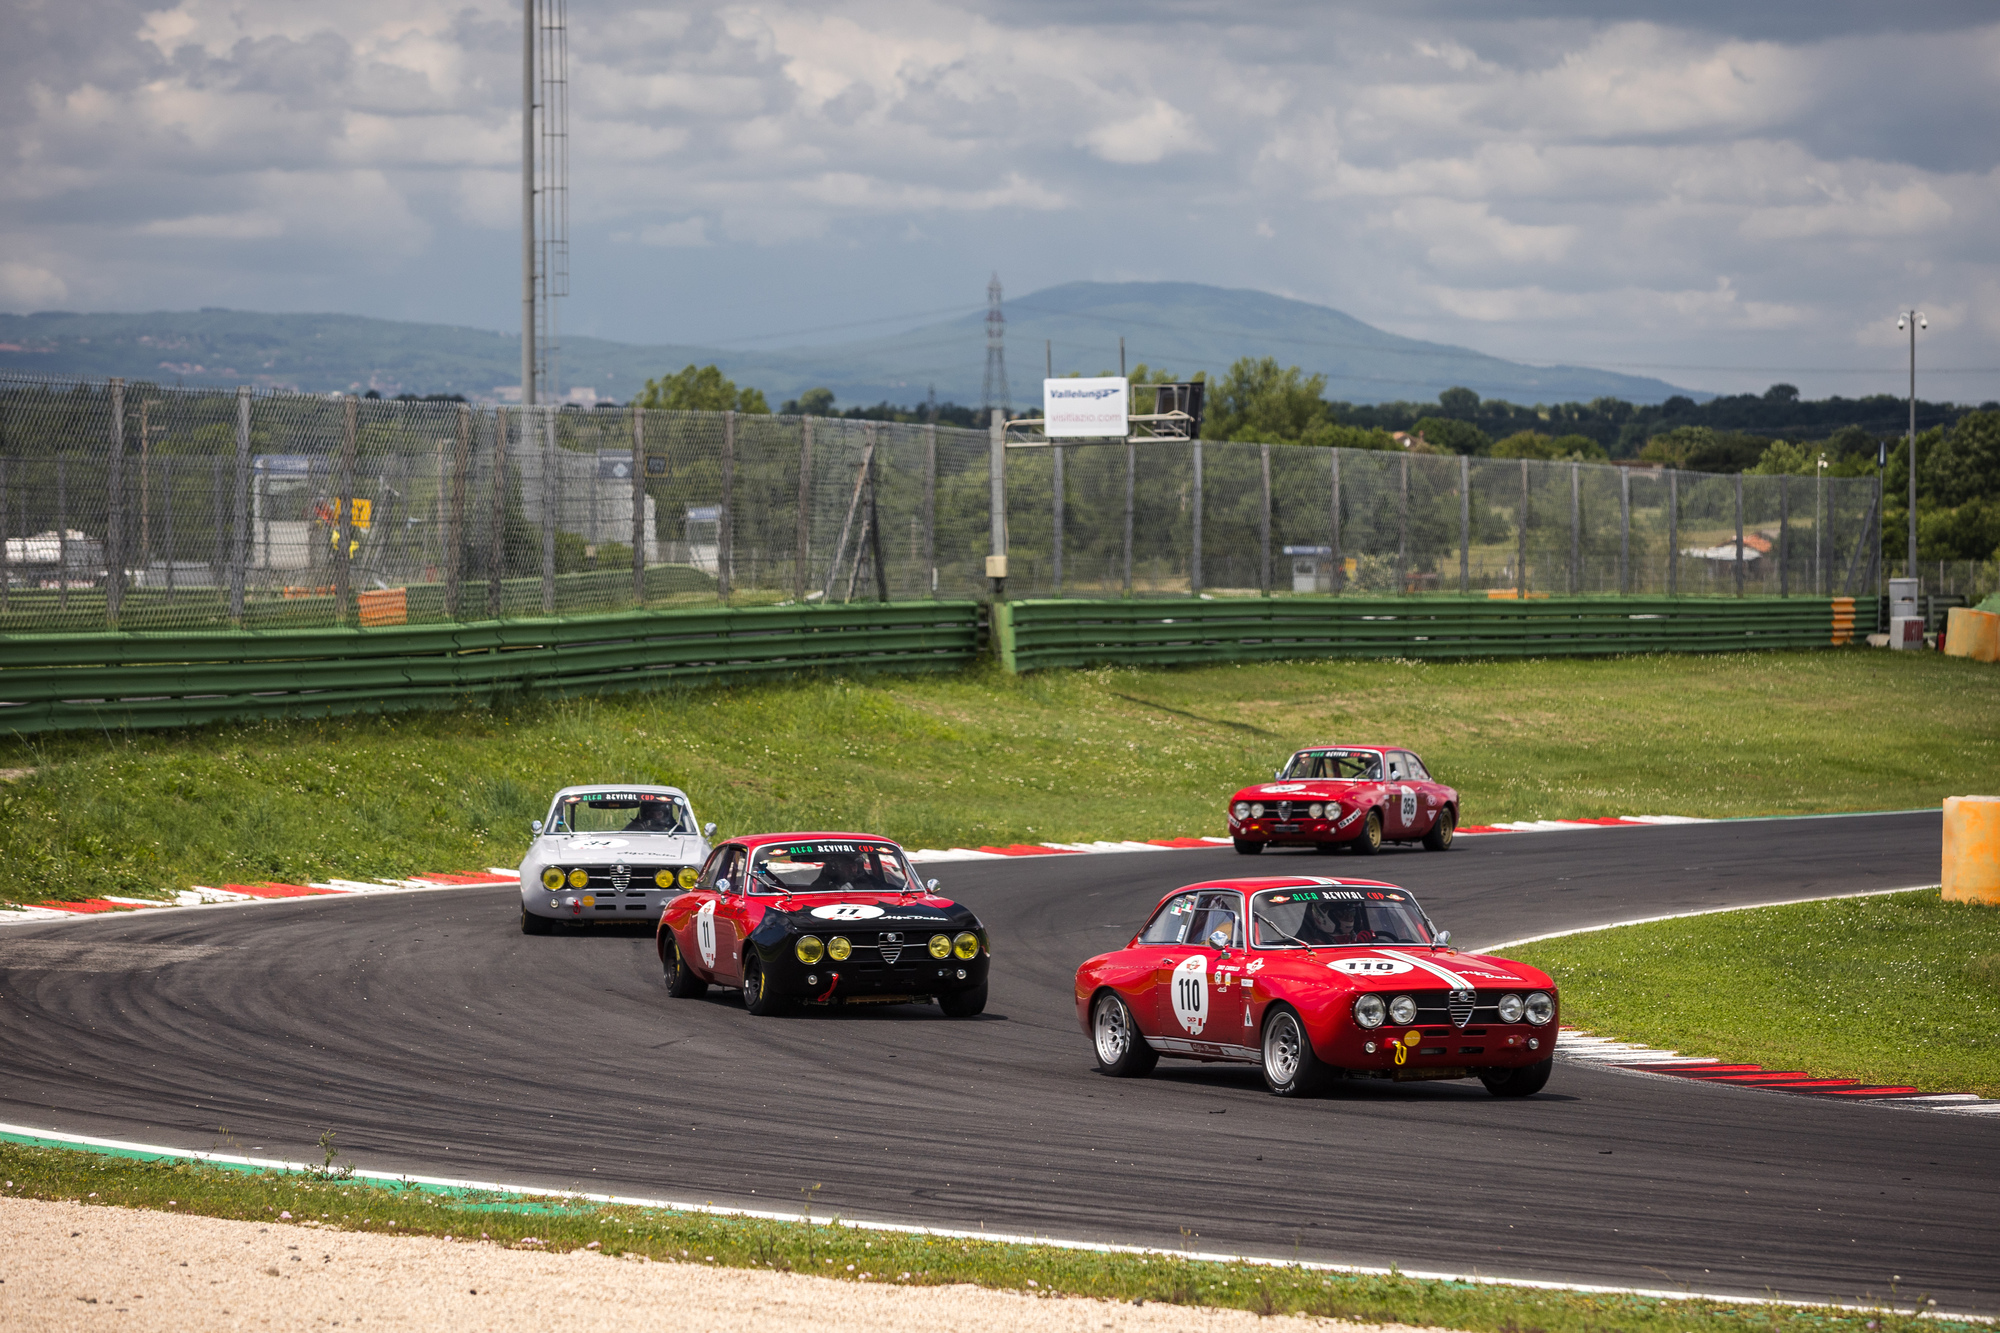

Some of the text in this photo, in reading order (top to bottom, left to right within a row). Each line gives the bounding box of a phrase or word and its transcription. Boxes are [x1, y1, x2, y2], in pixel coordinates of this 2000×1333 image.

[1050, 389, 1119, 400] Vallelunga
[606, 793, 637, 801] REVIVAL
[1403, 797, 1415, 815] 356
[790, 844, 874, 854] ALFA REVIVAL CUP
[1292, 891, 1385, 902] ALFA REVIVAL CUP
[702, 920, 711, 949] 11
[1345, 962, 1394, 971] 110
[1178, 978, 1200, 1012] 110
